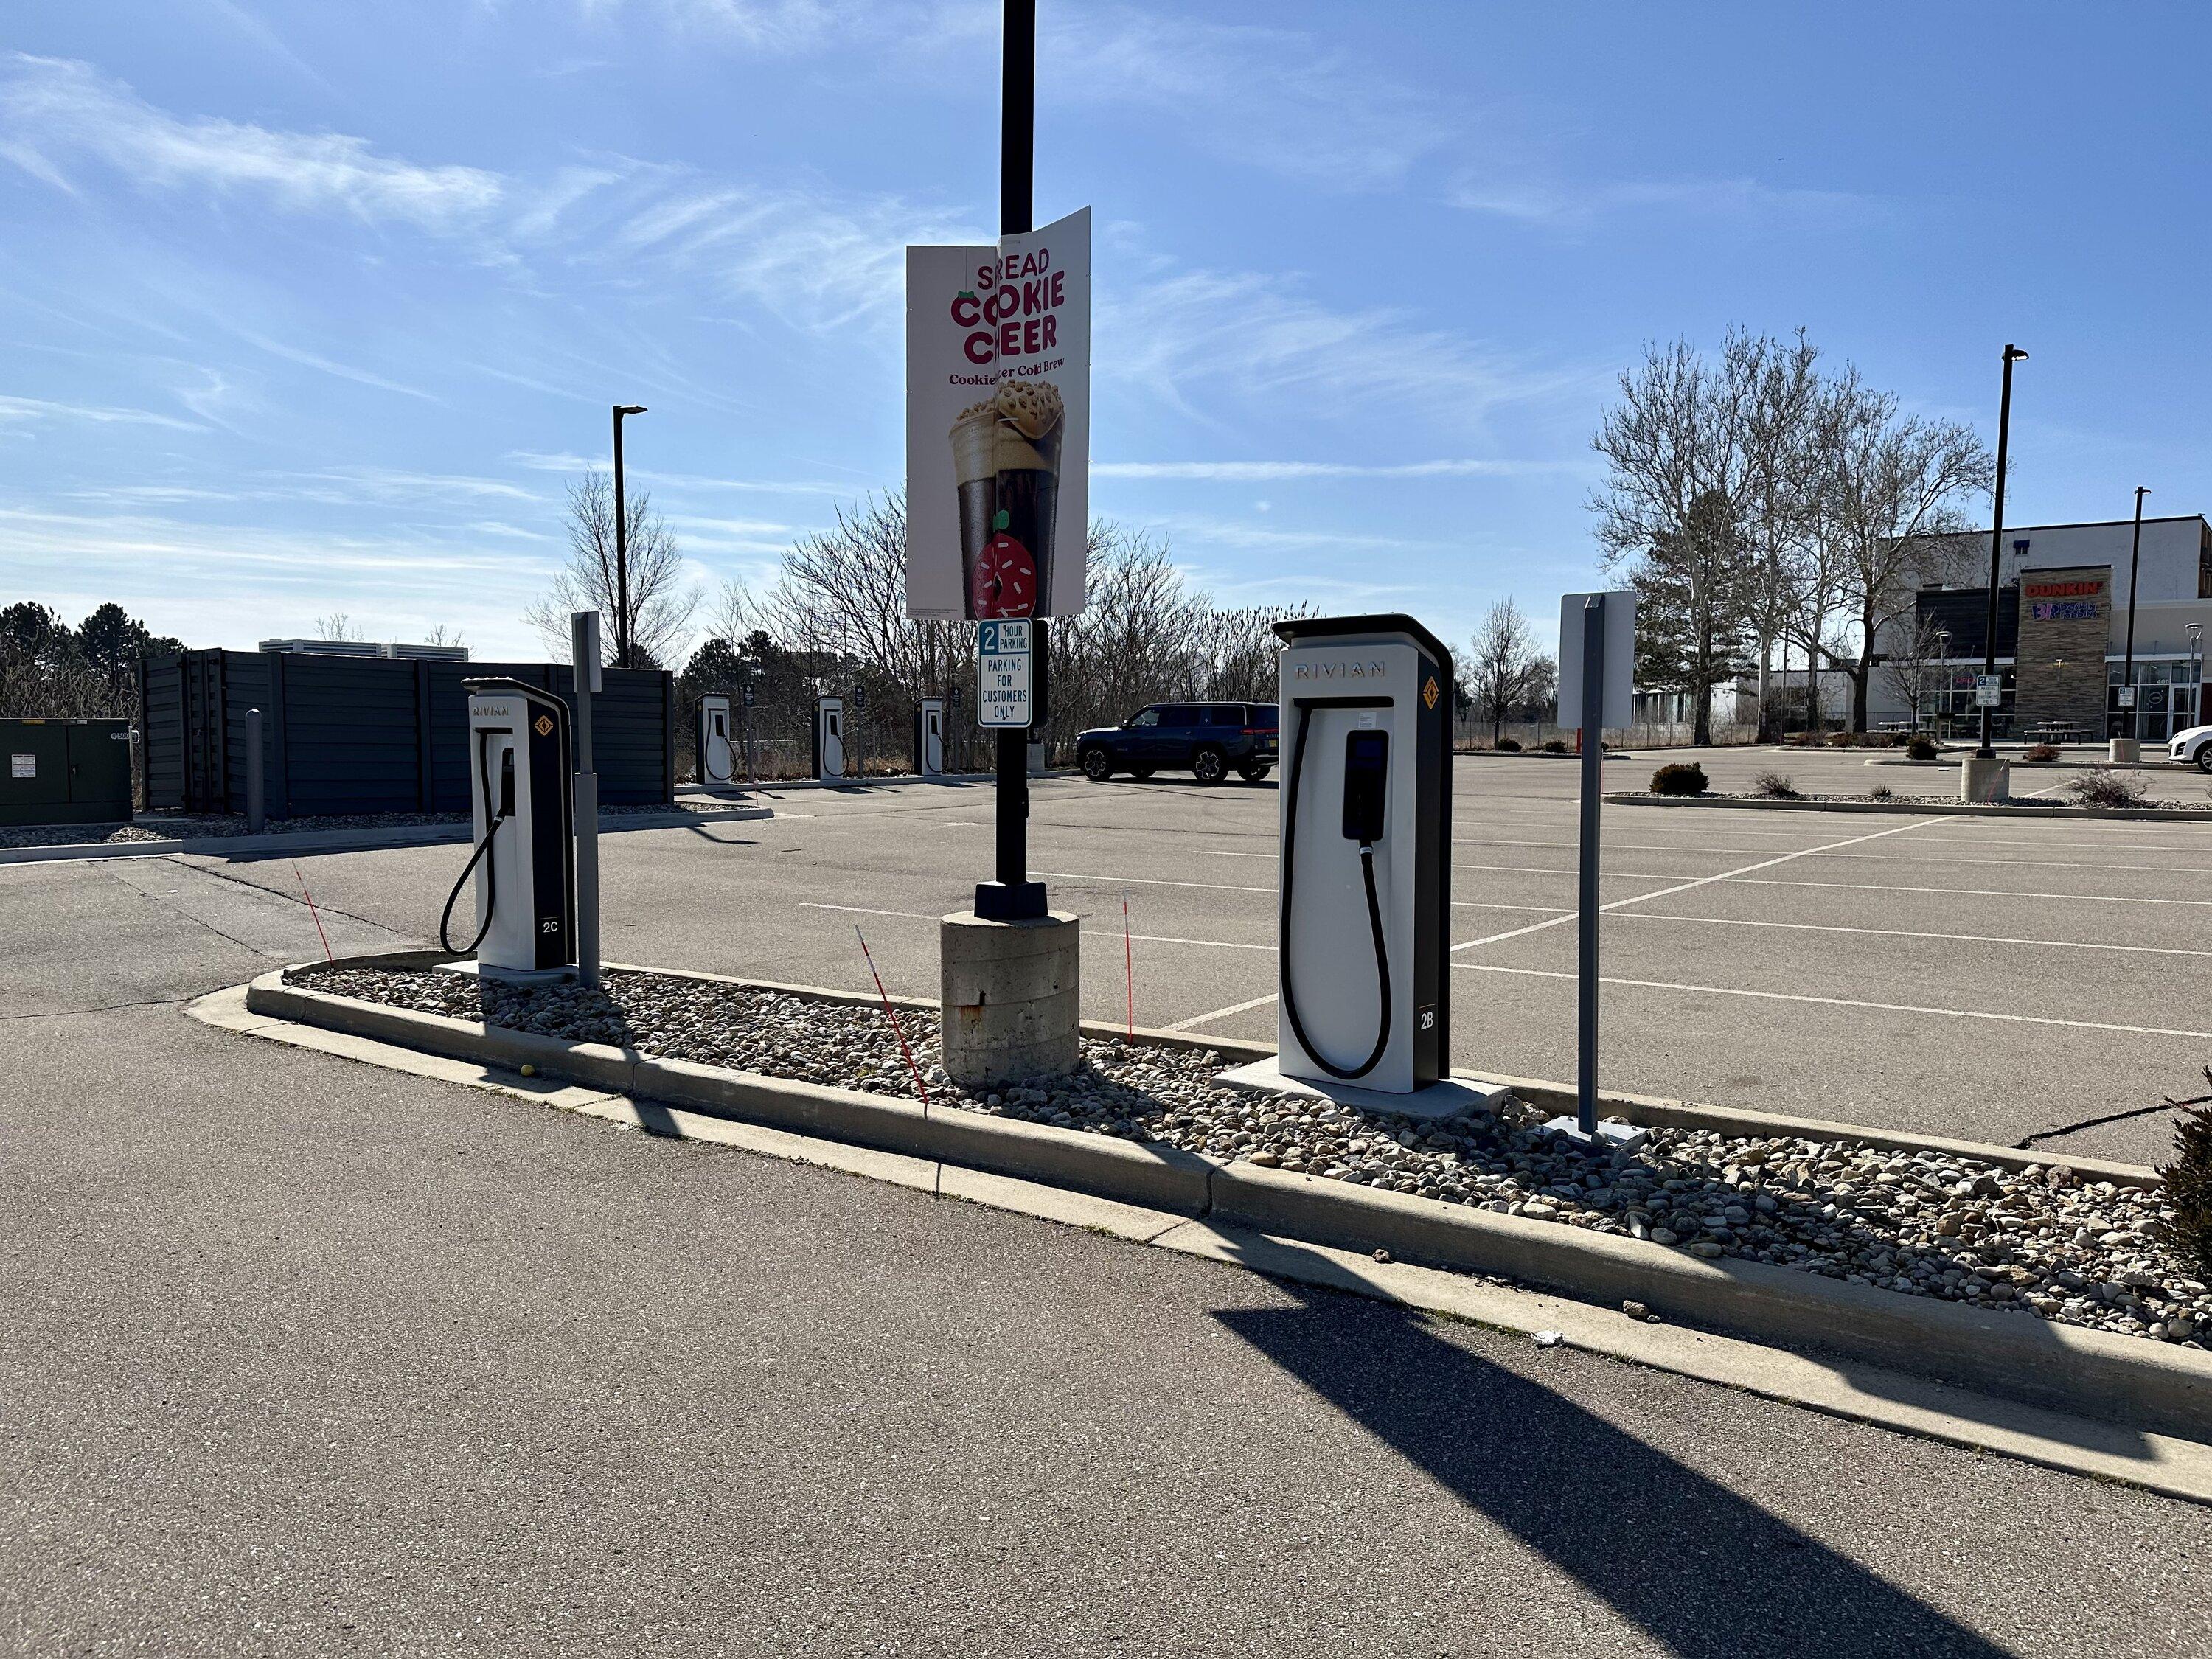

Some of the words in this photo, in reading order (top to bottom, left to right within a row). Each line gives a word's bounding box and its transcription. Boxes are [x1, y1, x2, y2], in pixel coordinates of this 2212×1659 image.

[964, 314, 1057, 365] CEER
[949, 374, 995, 386] Cookie
[1018, 363, 1042, 376] Cold
[1043, 358, 1065, 372] Brew
[984, 626, 995, 650] 2
[1004, 625, 1023, 637] HOUR
[1000, 637, 1028, 650] PARKING
[988, 658, 1022, 672] PARKING
[1294, 661, 1385, 679] RIVIAN
[997, 675, 1012, 687] FOR
[1980, 677, 1985, 685] 2
[982, 689, 1027, 703] CUSTOMERS
[473, 706, 509, 716] RIVIAN
[994, 706, 1015, 718] ONLY
[543, 921, 558, 933] 2C
[1421, 1011, 1433, 1030] 2B
